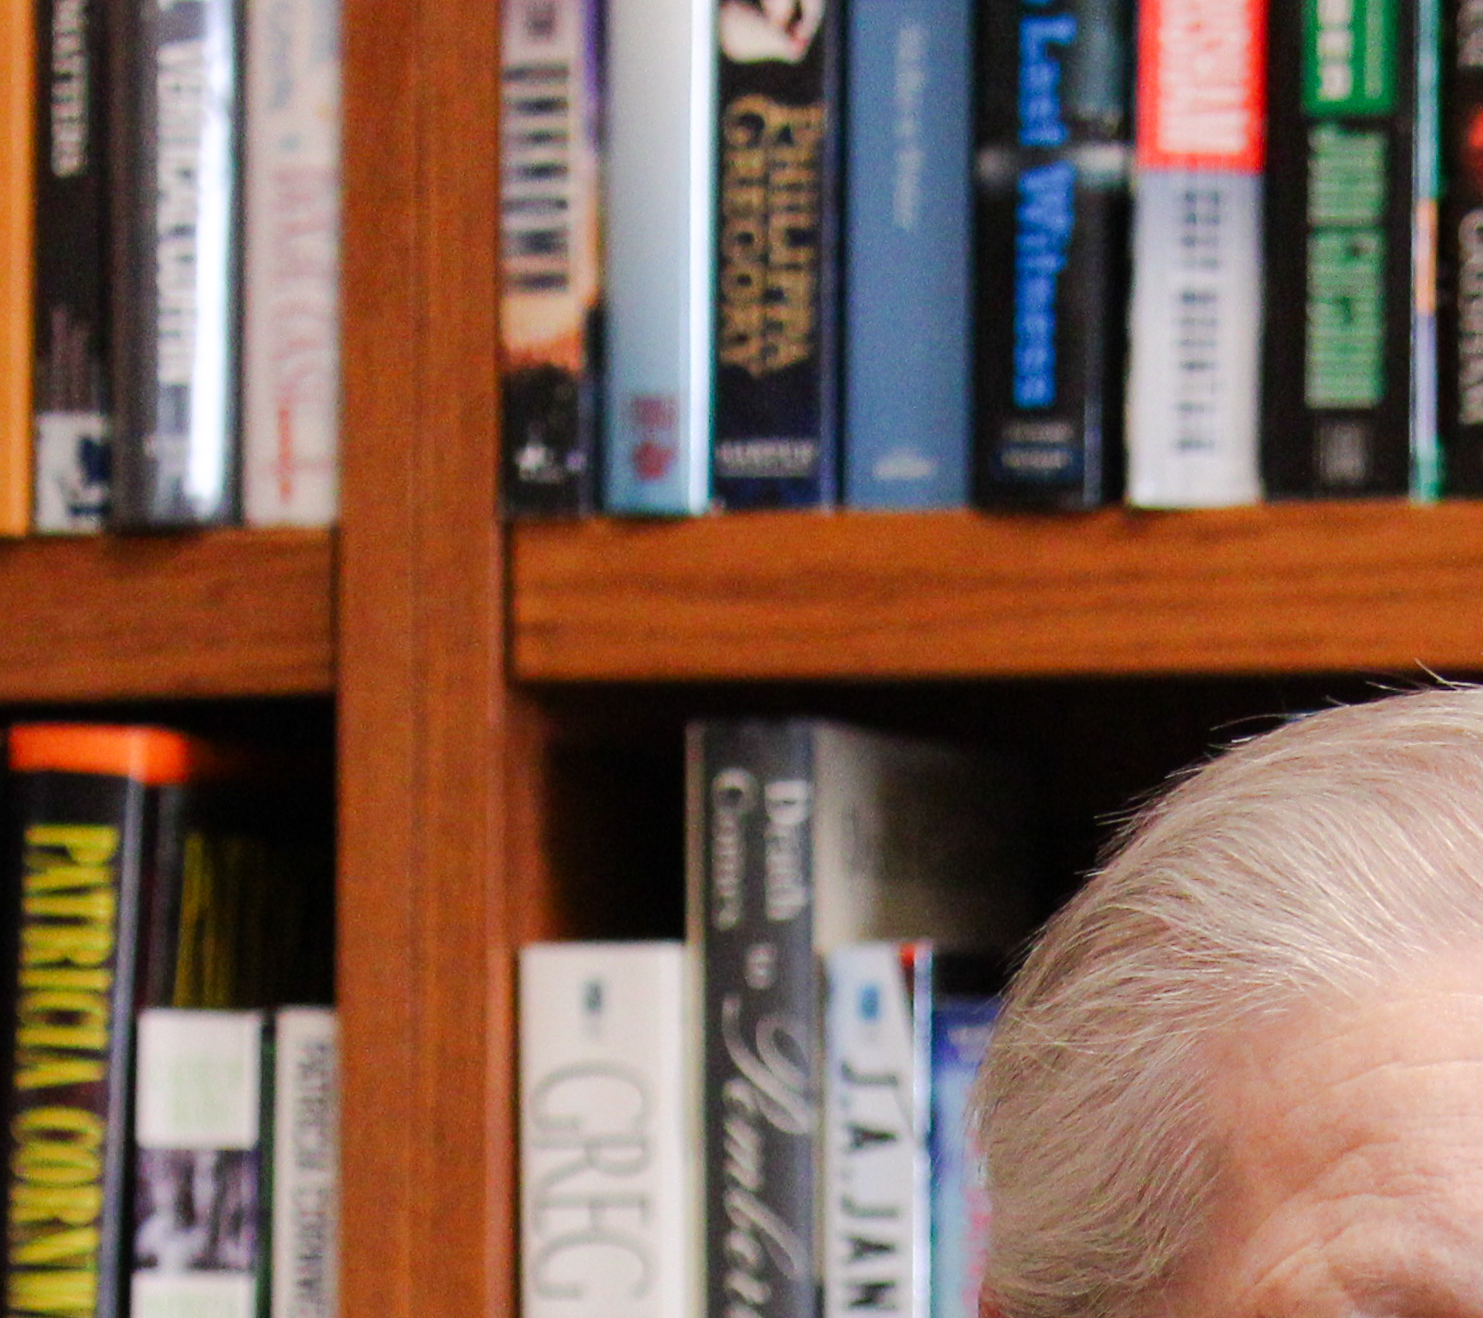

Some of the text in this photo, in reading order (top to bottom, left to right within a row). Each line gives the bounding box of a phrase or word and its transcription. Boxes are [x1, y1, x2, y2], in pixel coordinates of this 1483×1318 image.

[719, 95, 773, 377] GREGORY
[763, 105, 826, 367] PHILIPPA
[1013, 14, 1079, 409] Last Witness
[17, 823, 117, 1091] PATRICIA
[761, 779, 813, 921] Death
[527, 1059, 658, 1304] GREG
